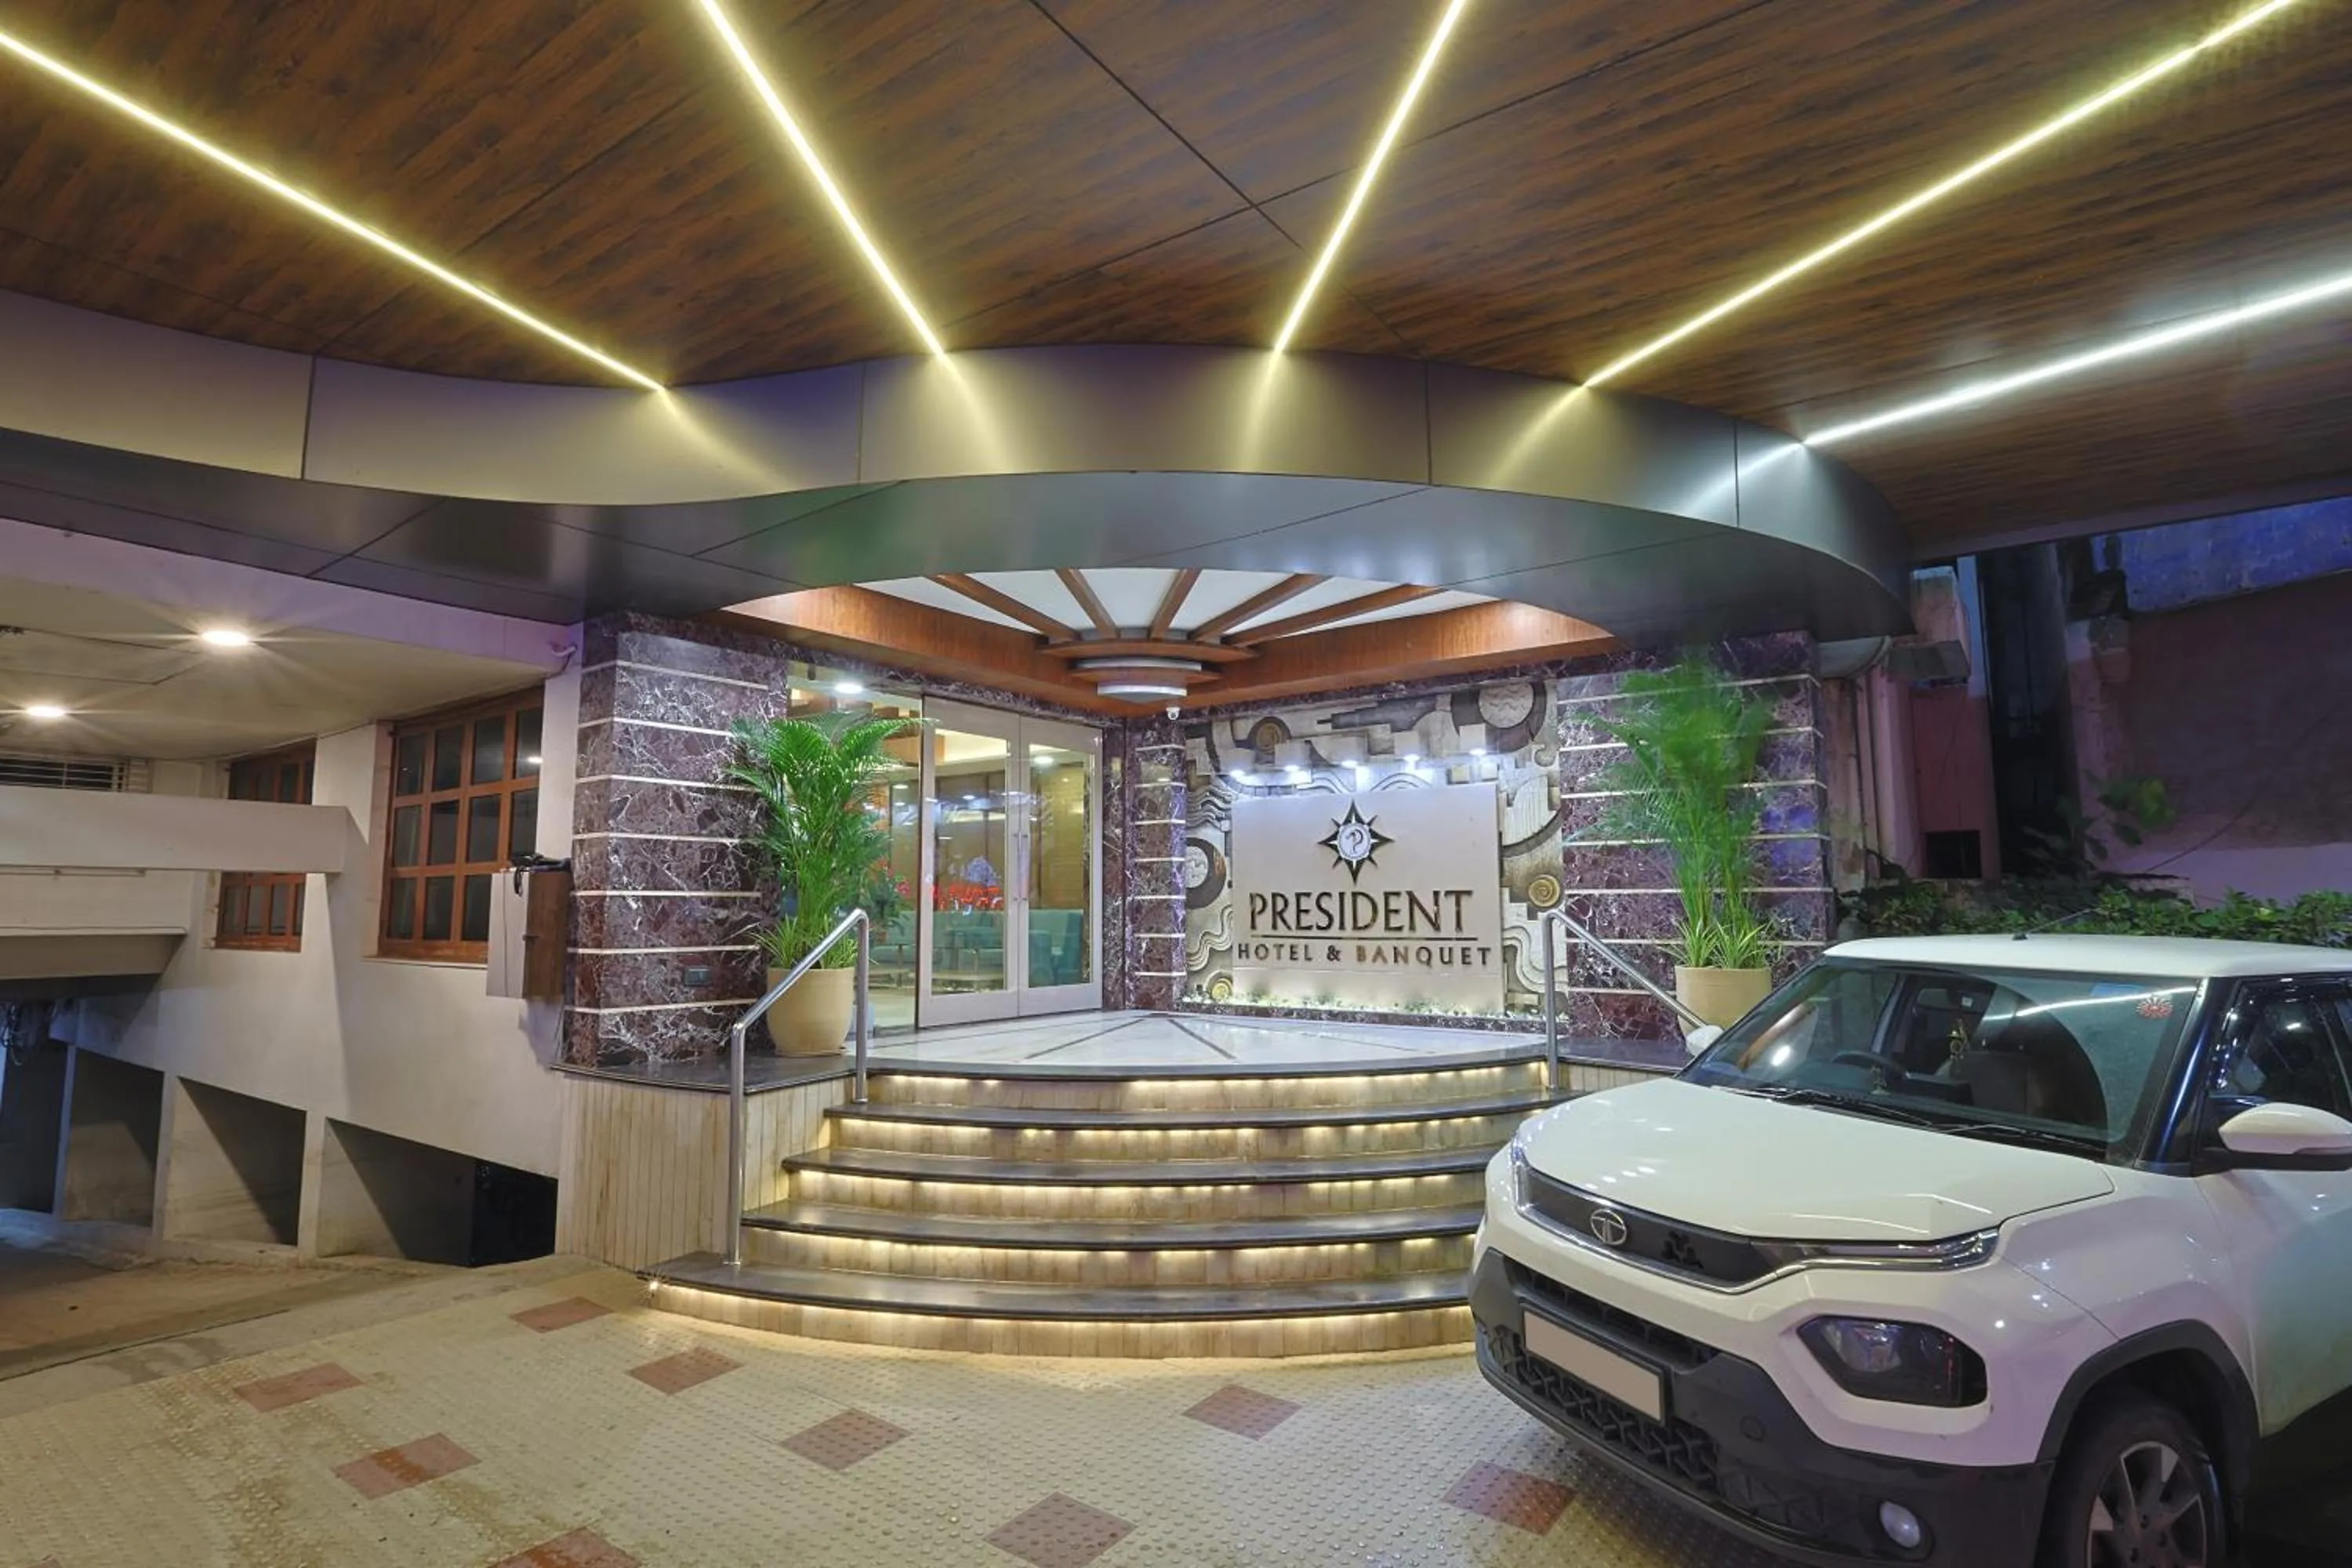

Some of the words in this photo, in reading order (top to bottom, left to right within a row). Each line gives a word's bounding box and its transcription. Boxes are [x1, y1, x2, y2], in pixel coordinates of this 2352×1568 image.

[1249, 890, 1473, 932] PRESIDENT
[1238, 943, 1313, 961] HOTEL
[1327, 945, 1341, 962] &
[1356, 945, 1491, 968] BANQUET
